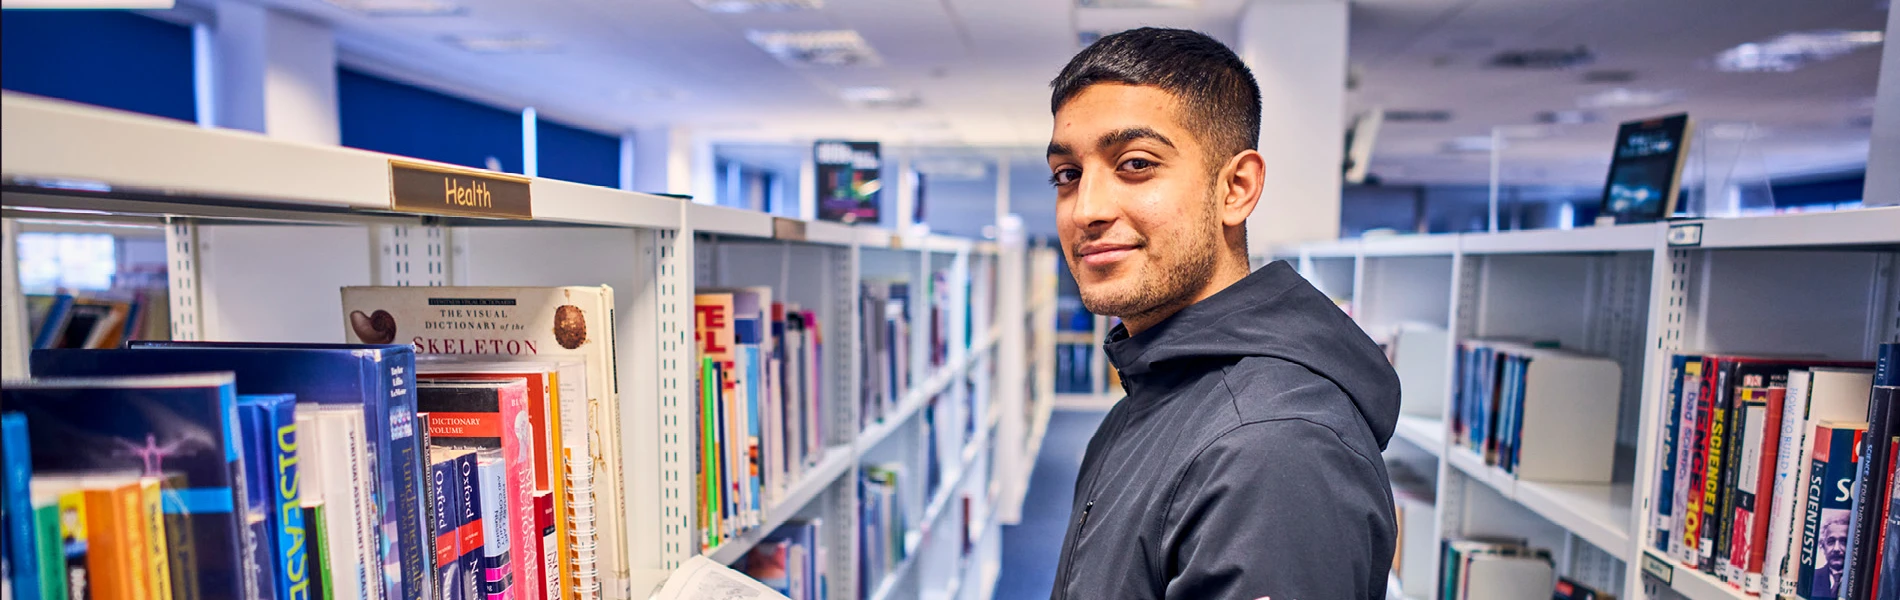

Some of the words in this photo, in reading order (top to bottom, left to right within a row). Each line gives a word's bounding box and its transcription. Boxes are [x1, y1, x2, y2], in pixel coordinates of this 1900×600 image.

[445, 177, 491, 208] Health
[425, 321, 496, 330] DICTIONARY
[500, 323, 508, 332] of
[440, 309, 462, 318] THE
[466, 310, 508, 318] VISUAL
[413, 336, 538, 356] SKELETON
[1685, 392, 1697, 421] bad
[1788, 386, 1799, 415] HOW
[432, 417, 480, 425] DICTIONARY
[1691, 357, 1713, 490] SCIENCE
[1785, 417, 1795, 434] TO
[1780, 436, 1792, 470] BUILD
[1863, 444, 1873, 476] SCIENCE
[349, 430, 358, 483] SPIRITUAL
[354, 486, 364, 550] ASSESSMENT
[359, 553, 365, 565] IN
[435, 470, 448, 529] Oxford
[462, 461, 475, 519] Oxford
[1859, 483, 1868, 504] FOUR
[402, 447, 424, 592] Fundamentals
[518, 469, 534, 581] DICTIONARY
[525, 467, 538, 573] MEDICAL
[1801, 476, 1822, 566] SCIENTISTS
[1854, 506, 1864, 545] THOUSAND
[1851, 546, 1860, 567] YEAR
[469, 558, 481, 600] Nurs
[1847, 568, 1857, 598] HISTORY
